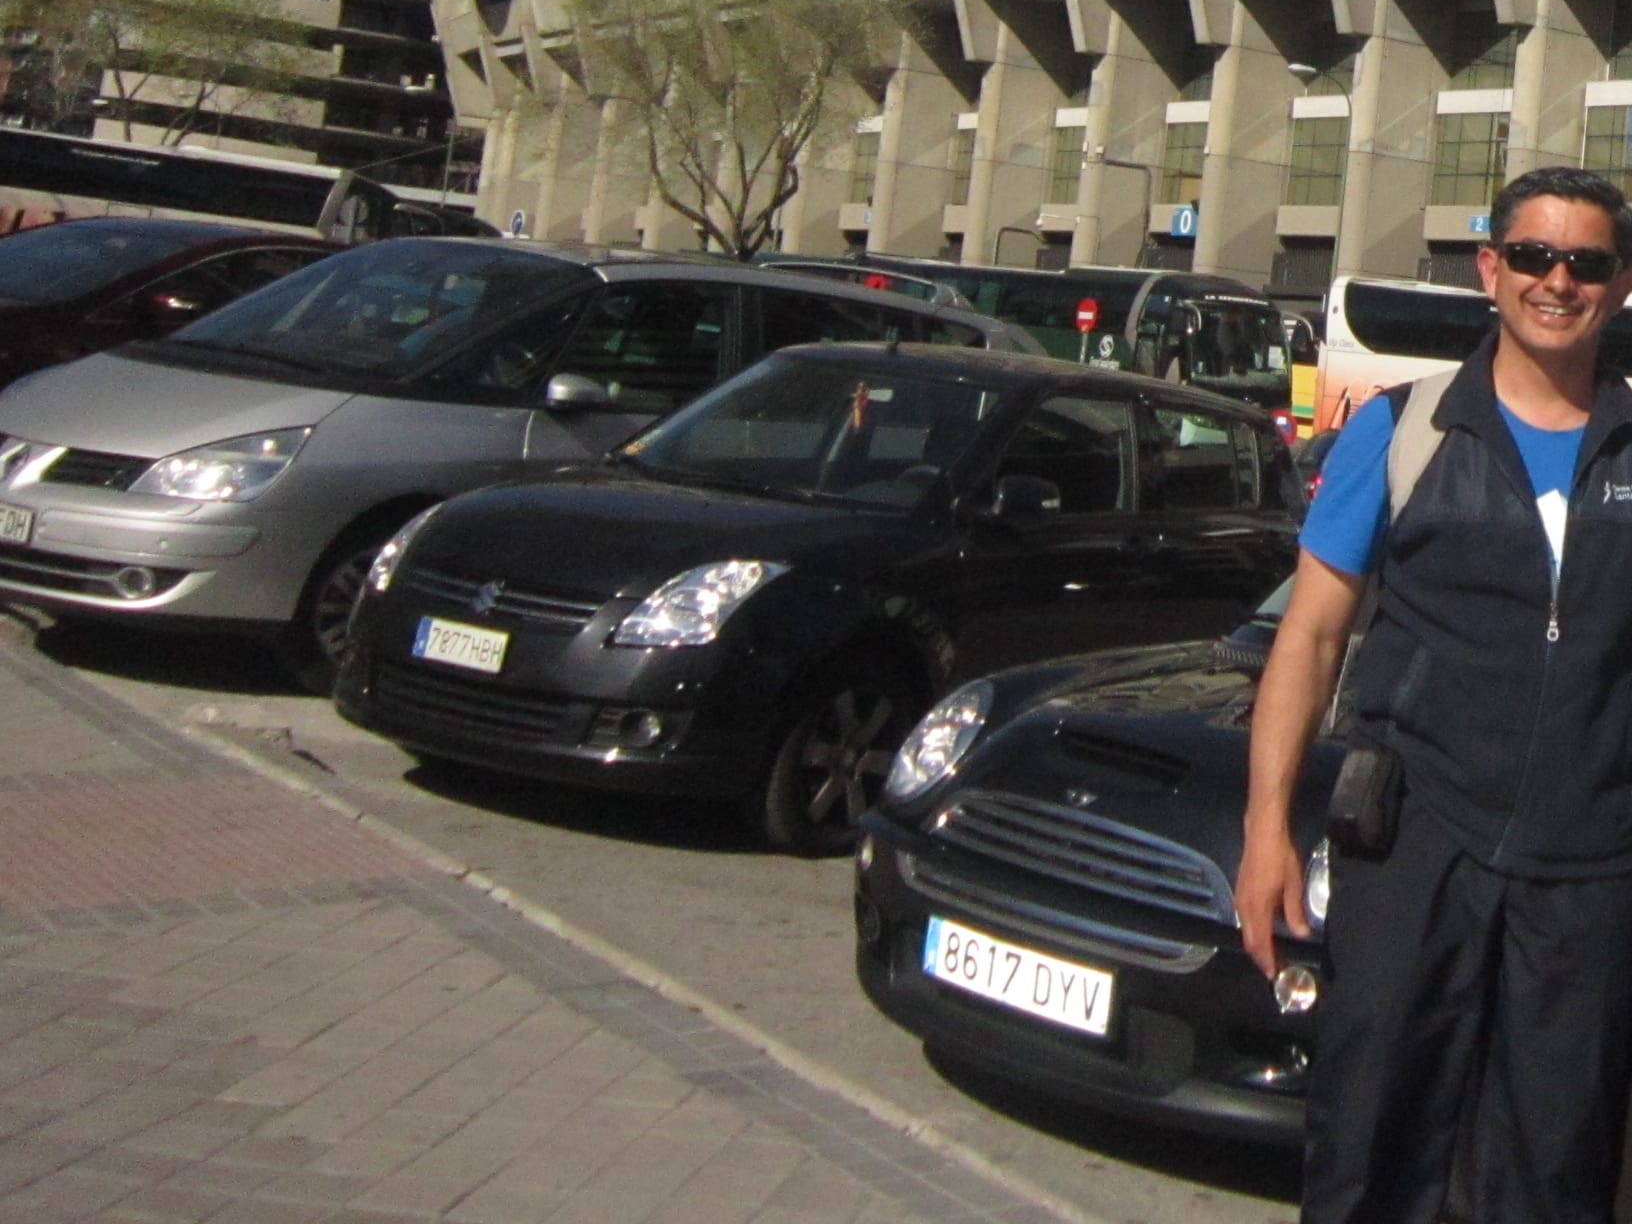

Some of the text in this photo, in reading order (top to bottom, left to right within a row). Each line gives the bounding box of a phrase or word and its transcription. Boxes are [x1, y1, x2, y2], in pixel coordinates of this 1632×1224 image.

[1180, 210, 1192, 234] 0
[1475, 216, 1484, 232] 2
[944, 932, 1100, 1021] 8617 DYV
